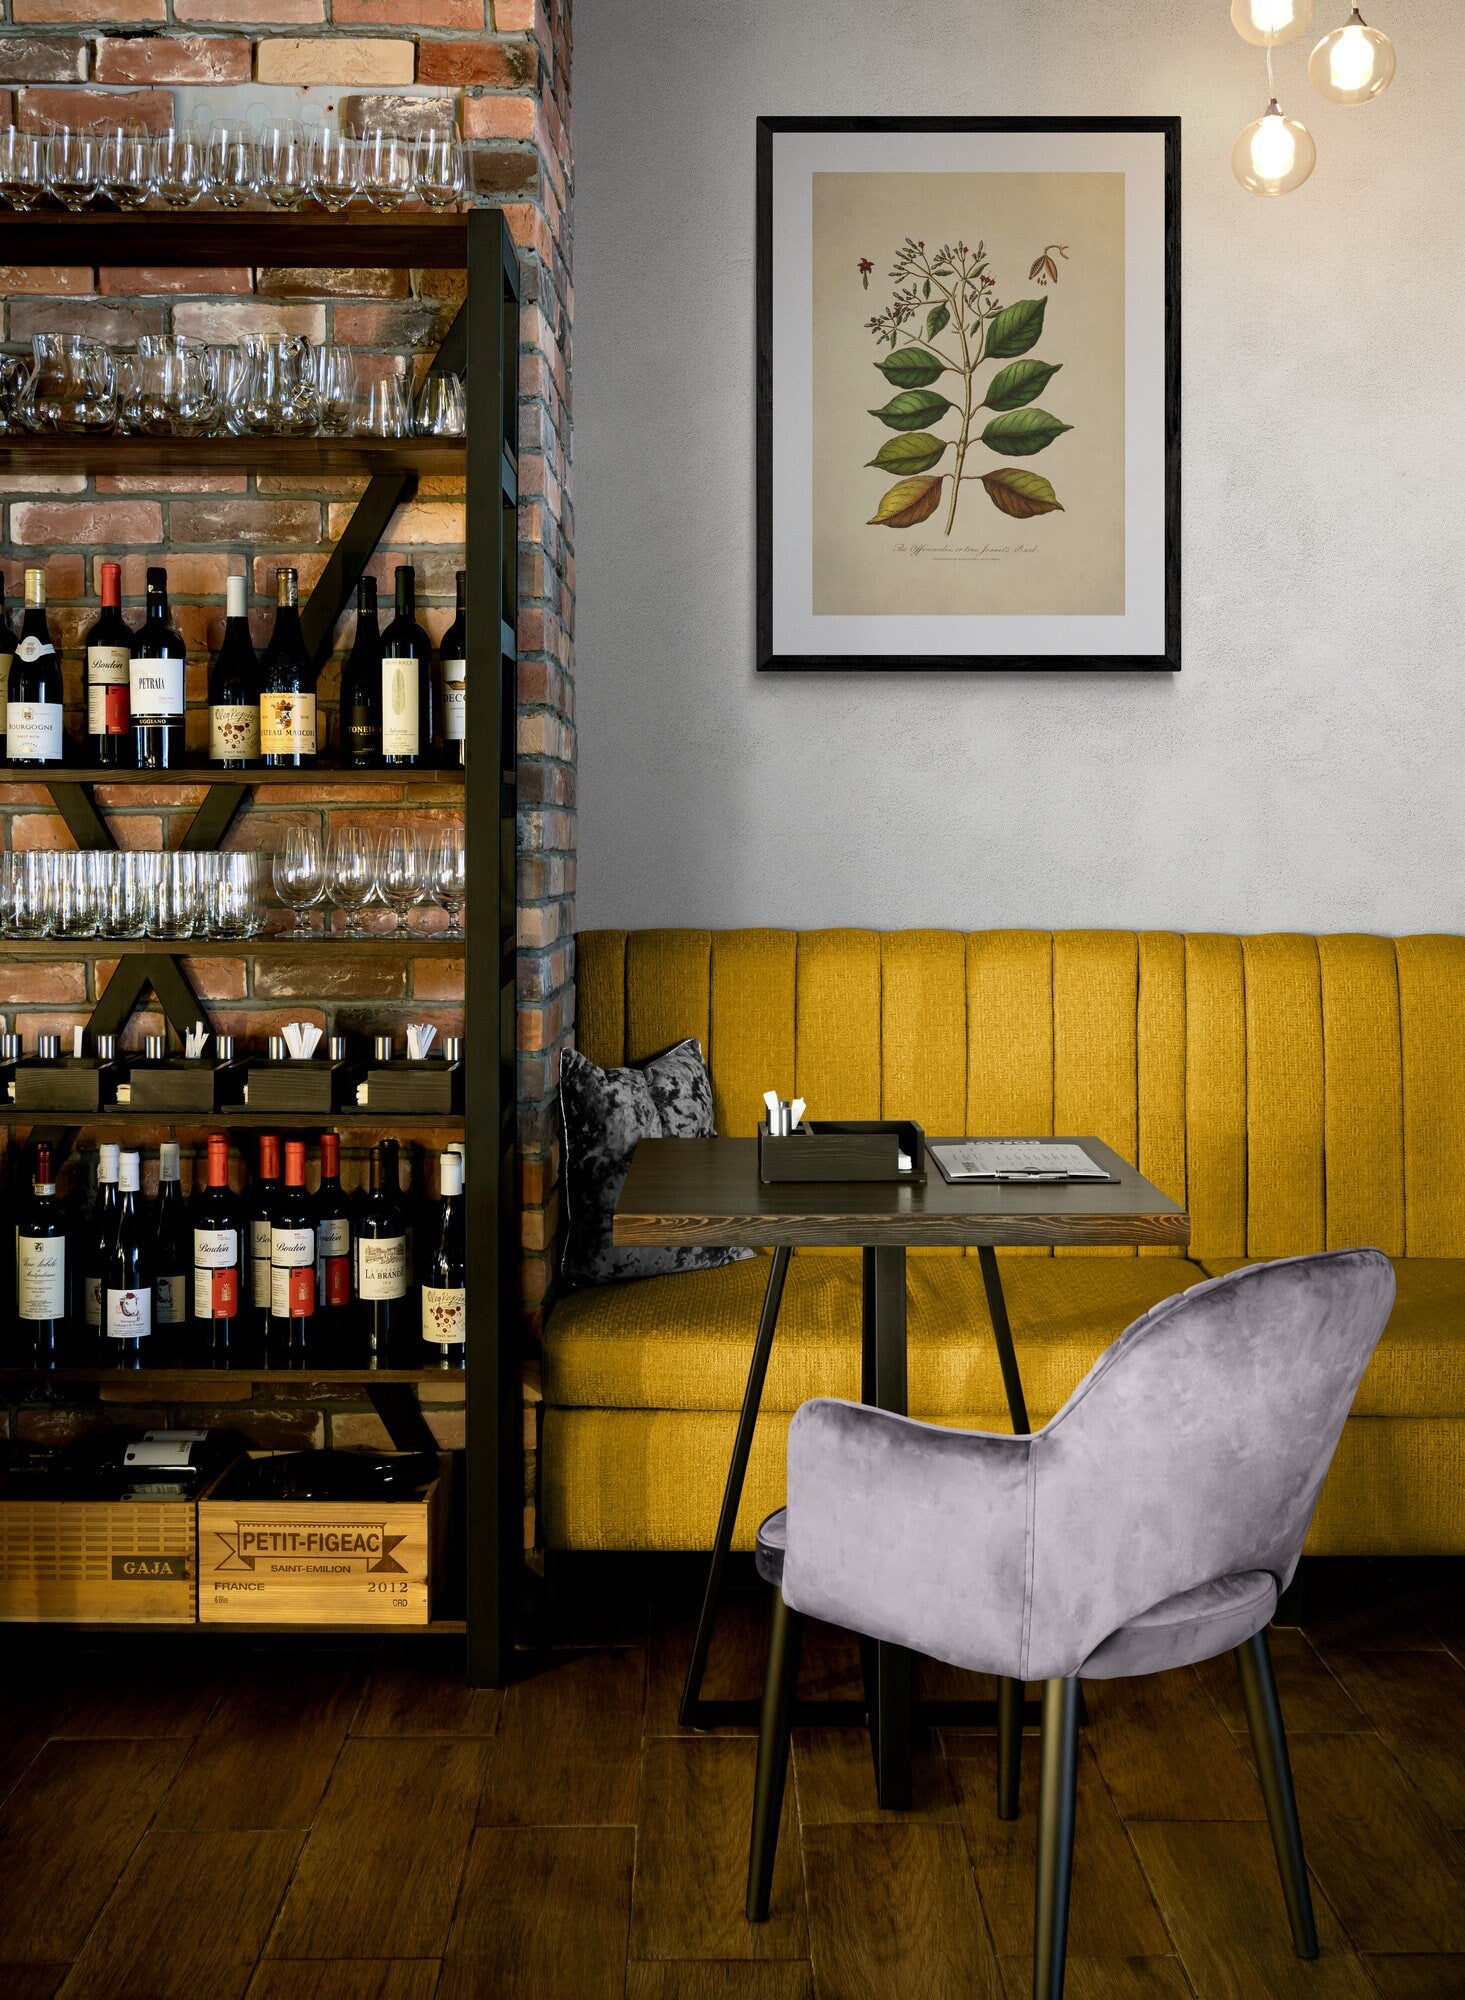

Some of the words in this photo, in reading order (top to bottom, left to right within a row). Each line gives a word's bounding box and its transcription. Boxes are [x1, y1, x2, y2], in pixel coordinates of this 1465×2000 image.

[92, 660, 124, 669] Bordón
[138, 677, 165, 690] PETRAIA
[8, 723, 54, 731] BOURGOGNE
[319, 1232, 343, 1242] ordón
[199, 1241, 230, 1253] Bordón
[276, 1241, 308, 1252] Bordón
[365, 1269, 375, 1279] LA
[243, 1532, 380, 1553] PETIT-FIGEAC
[123, 1561, 174, 1575] GAJA
[270, 1564, 351, 1573] SAINT-EMILION
[214, 1582, 265, 1591] FRANCE
[367, 1581, 408, 1593] 2012
[392, 1598, 408, 1607] CRD
